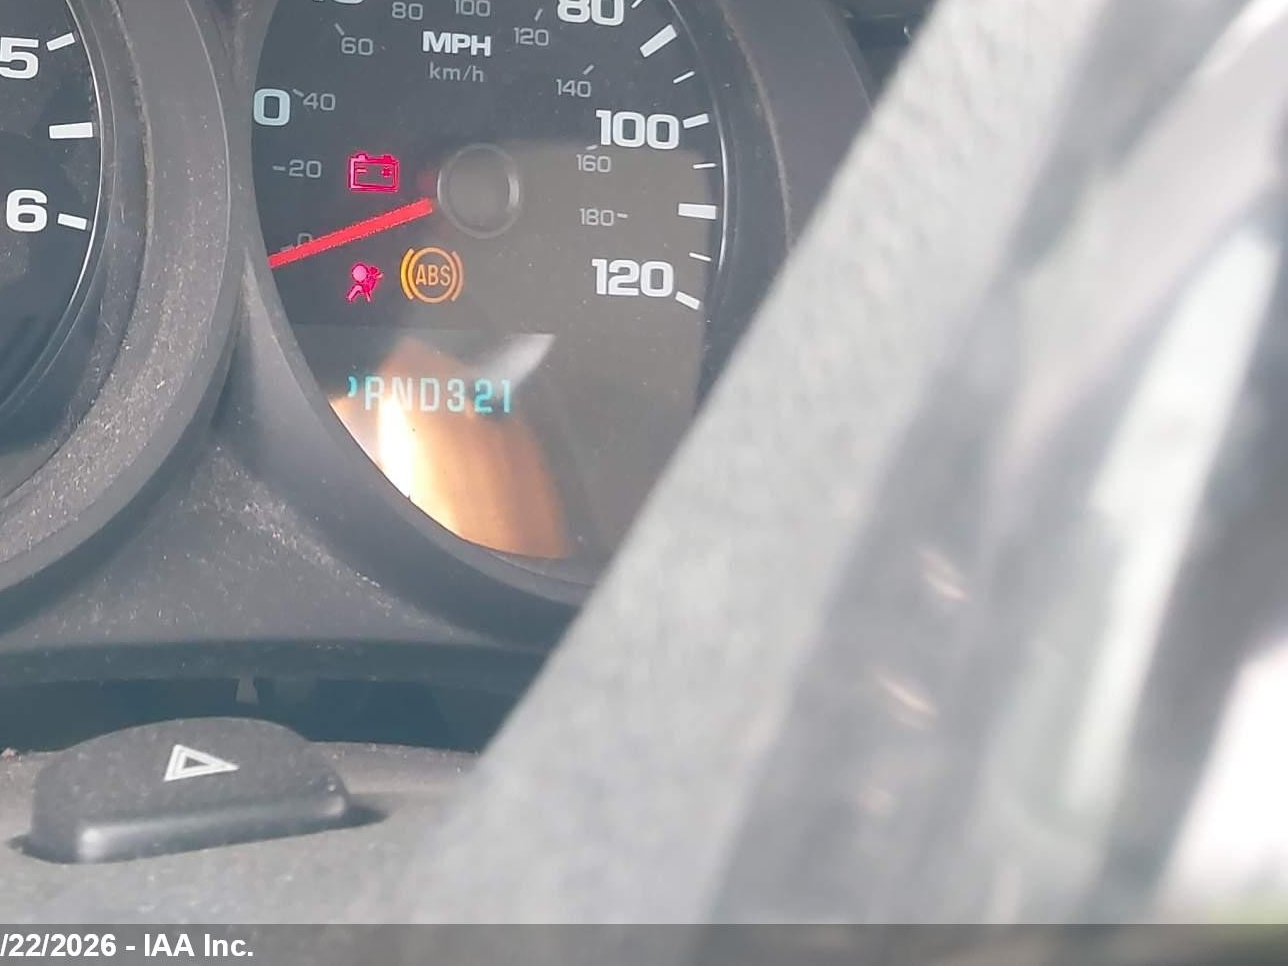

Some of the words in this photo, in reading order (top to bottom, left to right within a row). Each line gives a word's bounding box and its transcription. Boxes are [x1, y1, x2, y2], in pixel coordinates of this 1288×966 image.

[391, 2, 424, 22] 80
[341, 37, 374, 57] 60
[422, 32, 492, 58] MPH
[514, 27, 550, 47] 120
[429, 62, 485, 84] km/h
[556, 79, 592, 100] 140
[254, 88, 291, 126] 0
[303, 93, 336, 111] 40
[597, 109, 680, 151] 100
[289, 159, 323, 179] 20
[576, 154, 611, 174] 160
[5, 190, 49, 232] 6
[579, 208, 615, 227] 180
[415, 264, 452, 286] ABS
[592, 259, 674, 297] 120
